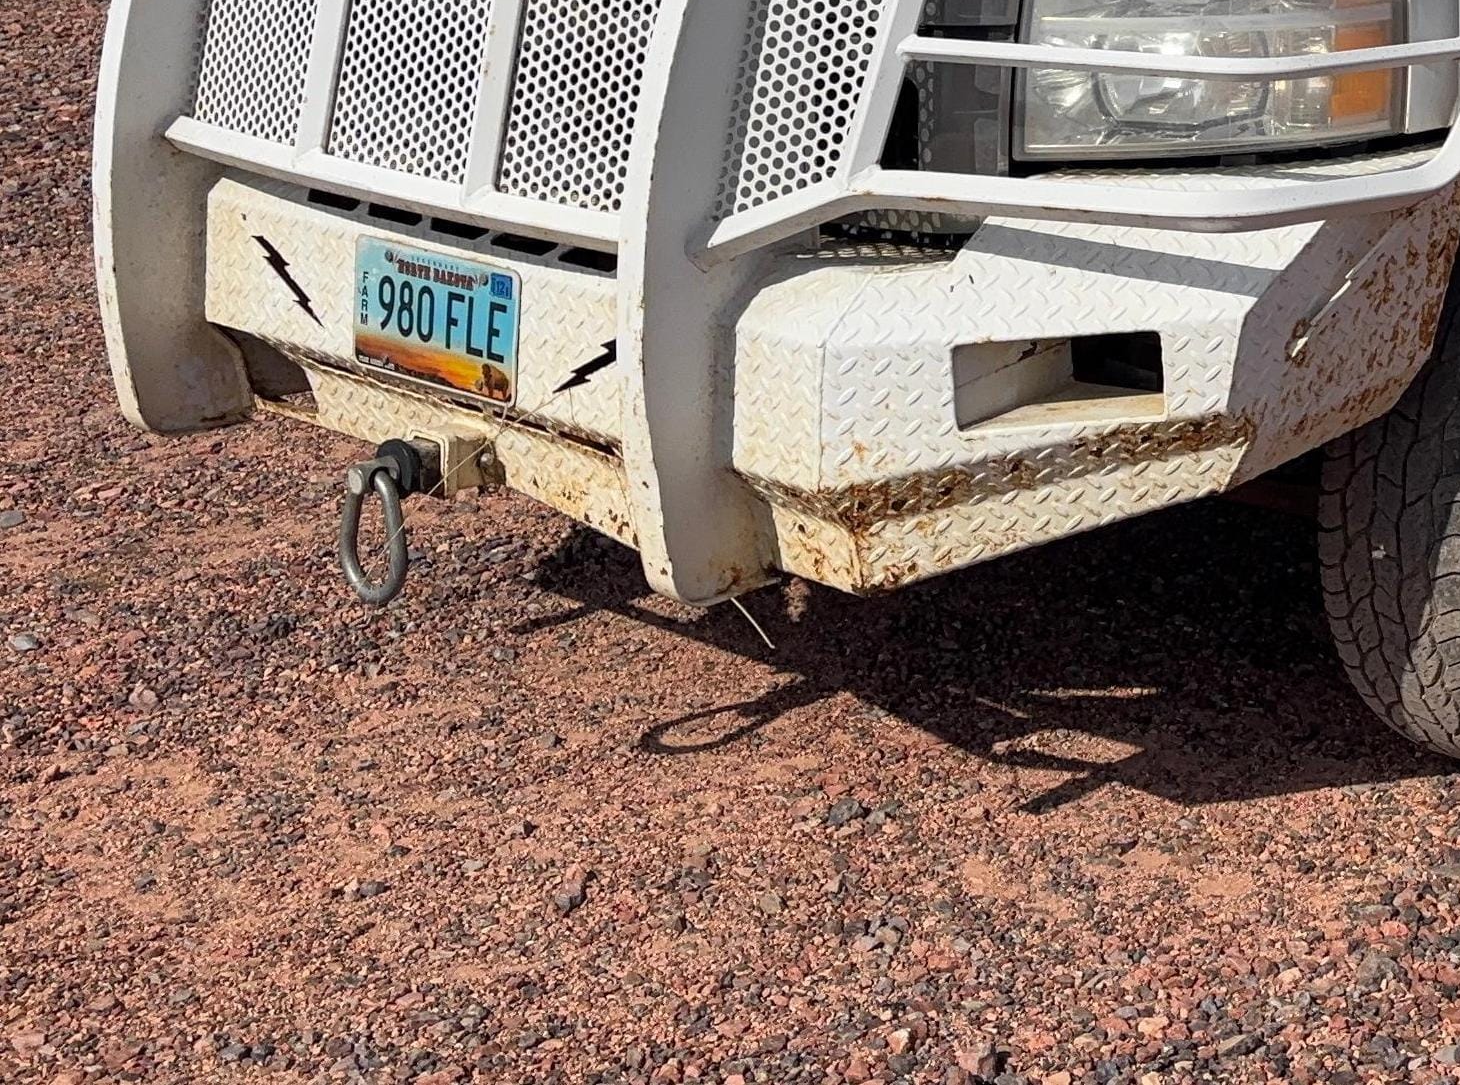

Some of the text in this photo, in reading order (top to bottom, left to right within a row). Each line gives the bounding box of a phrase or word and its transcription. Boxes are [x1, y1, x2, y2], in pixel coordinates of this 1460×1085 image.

[360, 271, 369, 326] FARM
[397, 259, 432, 281] NORTH
[432, 268, 474, 291] DAKOTA
[378, 275, 508, 364] 980 FLE
